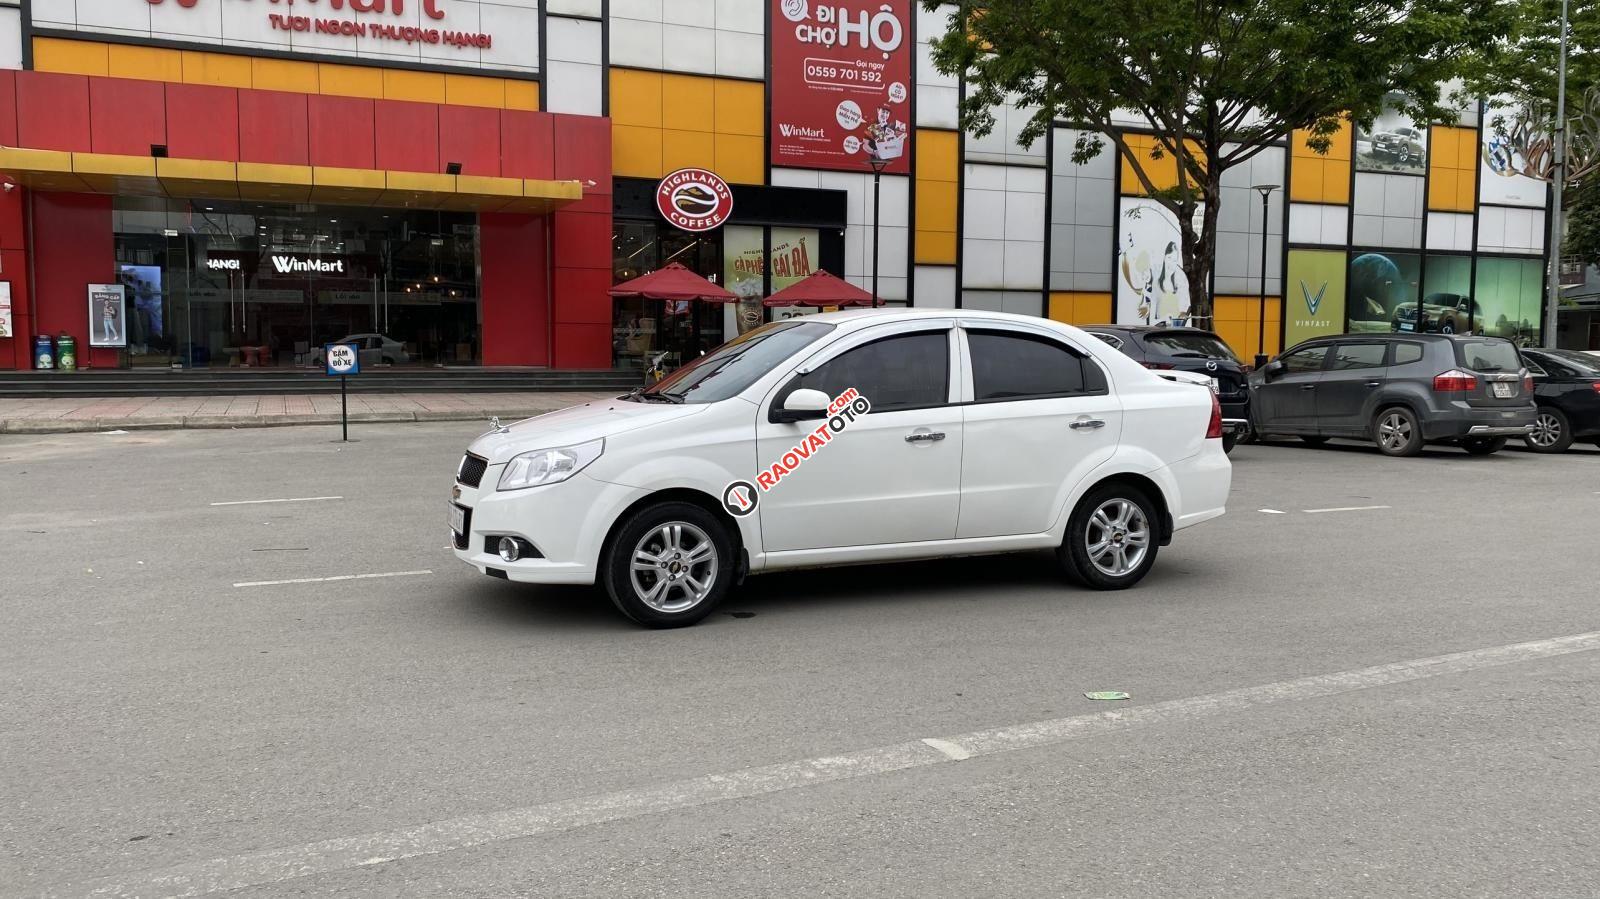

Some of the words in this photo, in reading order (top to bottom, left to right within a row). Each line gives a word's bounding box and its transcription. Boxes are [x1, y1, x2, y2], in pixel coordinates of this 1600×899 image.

[816, 5, 836, 23] ĐI
[315, 18, 365, 37] NGON
[795, 24, 837, 48] CHỢ
[838, 4, 903, 59] HỘ
[807, 65, 837, 78] 0559
[839, 68, 858, 80] 701
[861, 71, 882, 82] 592
[856, 60, 867, 68] Gọi
[868, 62, 885, 70] ngay
[779, 123, 825, 138] WinMart
[662, 172, 729, 199] HIGHLANDS
[670, 212, 721, 228] COFFEE
[272, 255, 344, 273] WinMart
